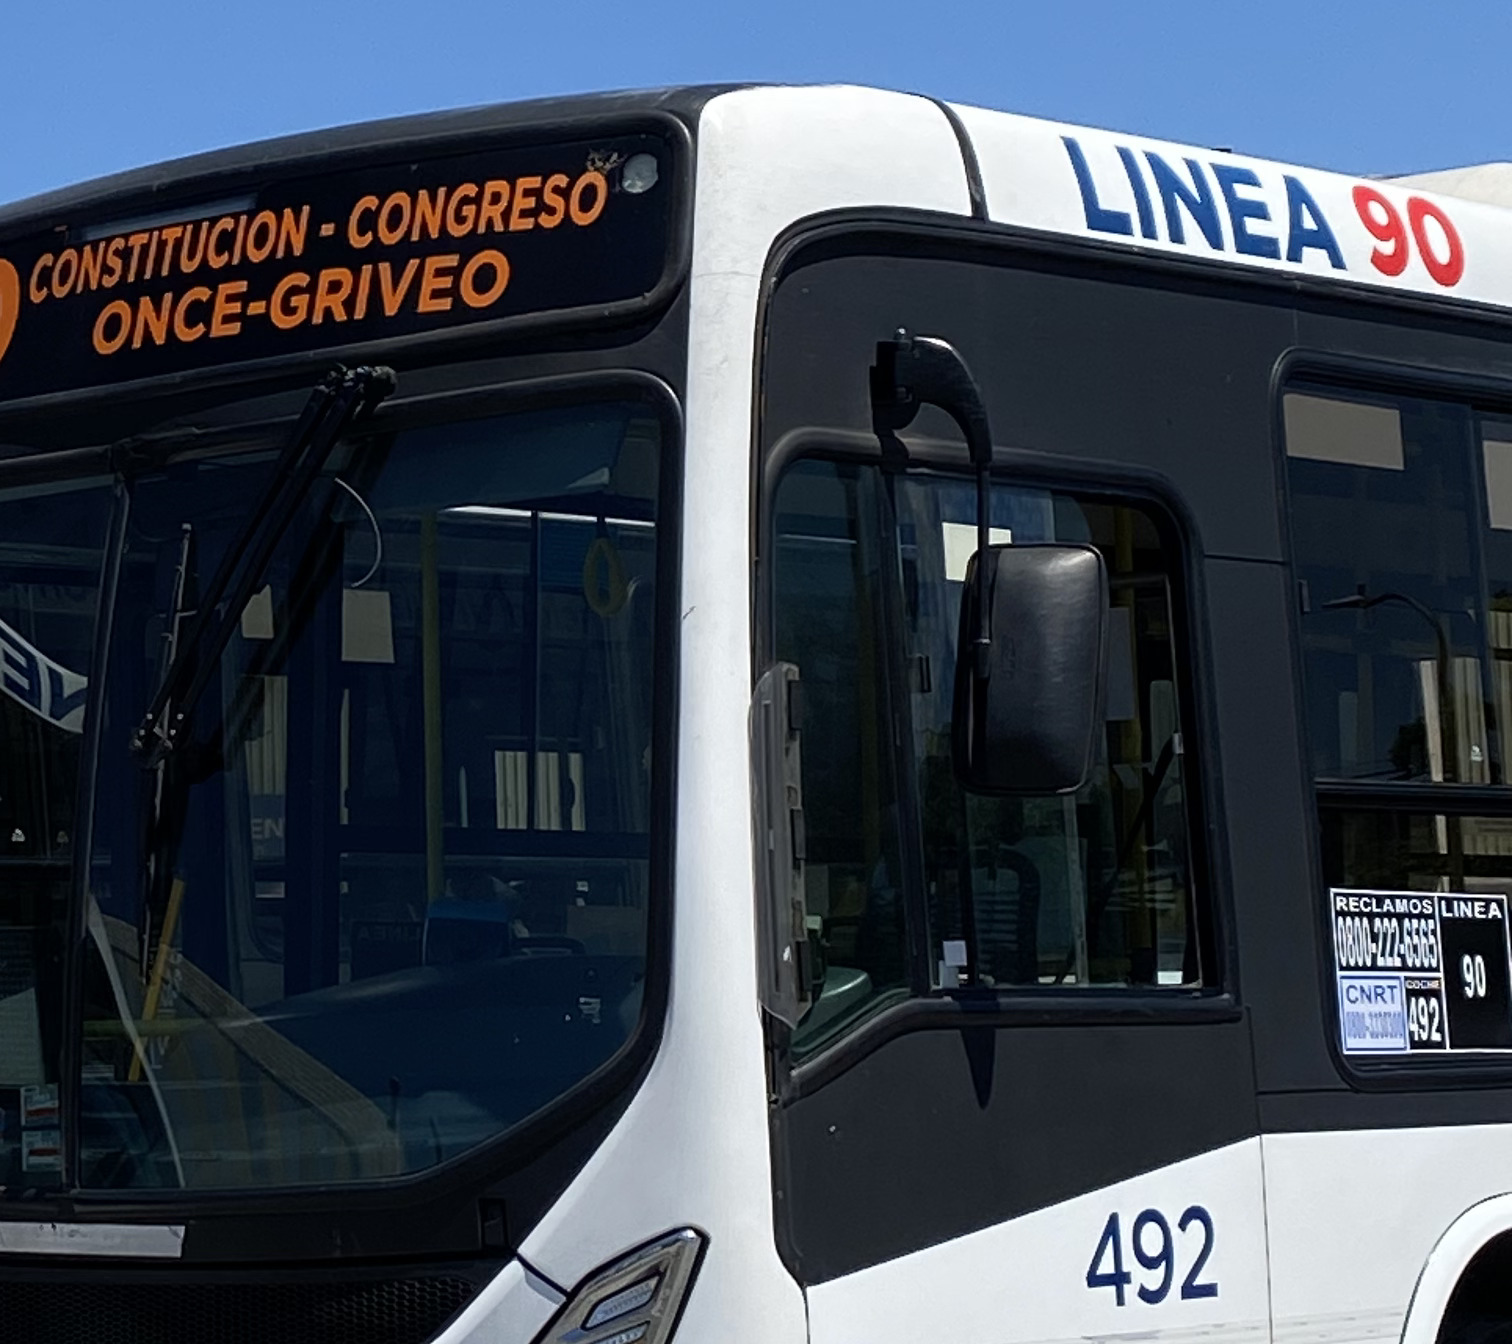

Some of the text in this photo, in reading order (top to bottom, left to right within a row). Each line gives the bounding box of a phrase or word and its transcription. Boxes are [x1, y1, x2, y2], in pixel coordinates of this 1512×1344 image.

[1060, 135, 1465, 287] LINEA 90
[28, 204, 310, 304] CONSTITUCION
[346, 171, 608, 246] CONGRESO
[92, 249, 511, 356] ONCE-GRIVEO
[1335, 896, 1433, 914] RECLAMOS
[1440, 900, 1503, 919] LINEA
[1337, 916, 1438, 968] 0800-222-6565
[1345, 984, 1398, 1004] CNRT
[1461, 954, 1487, 999] 90
[1408, 997, 1443, 1042] 492
[1085, 1204, 1220, 1308] 492
